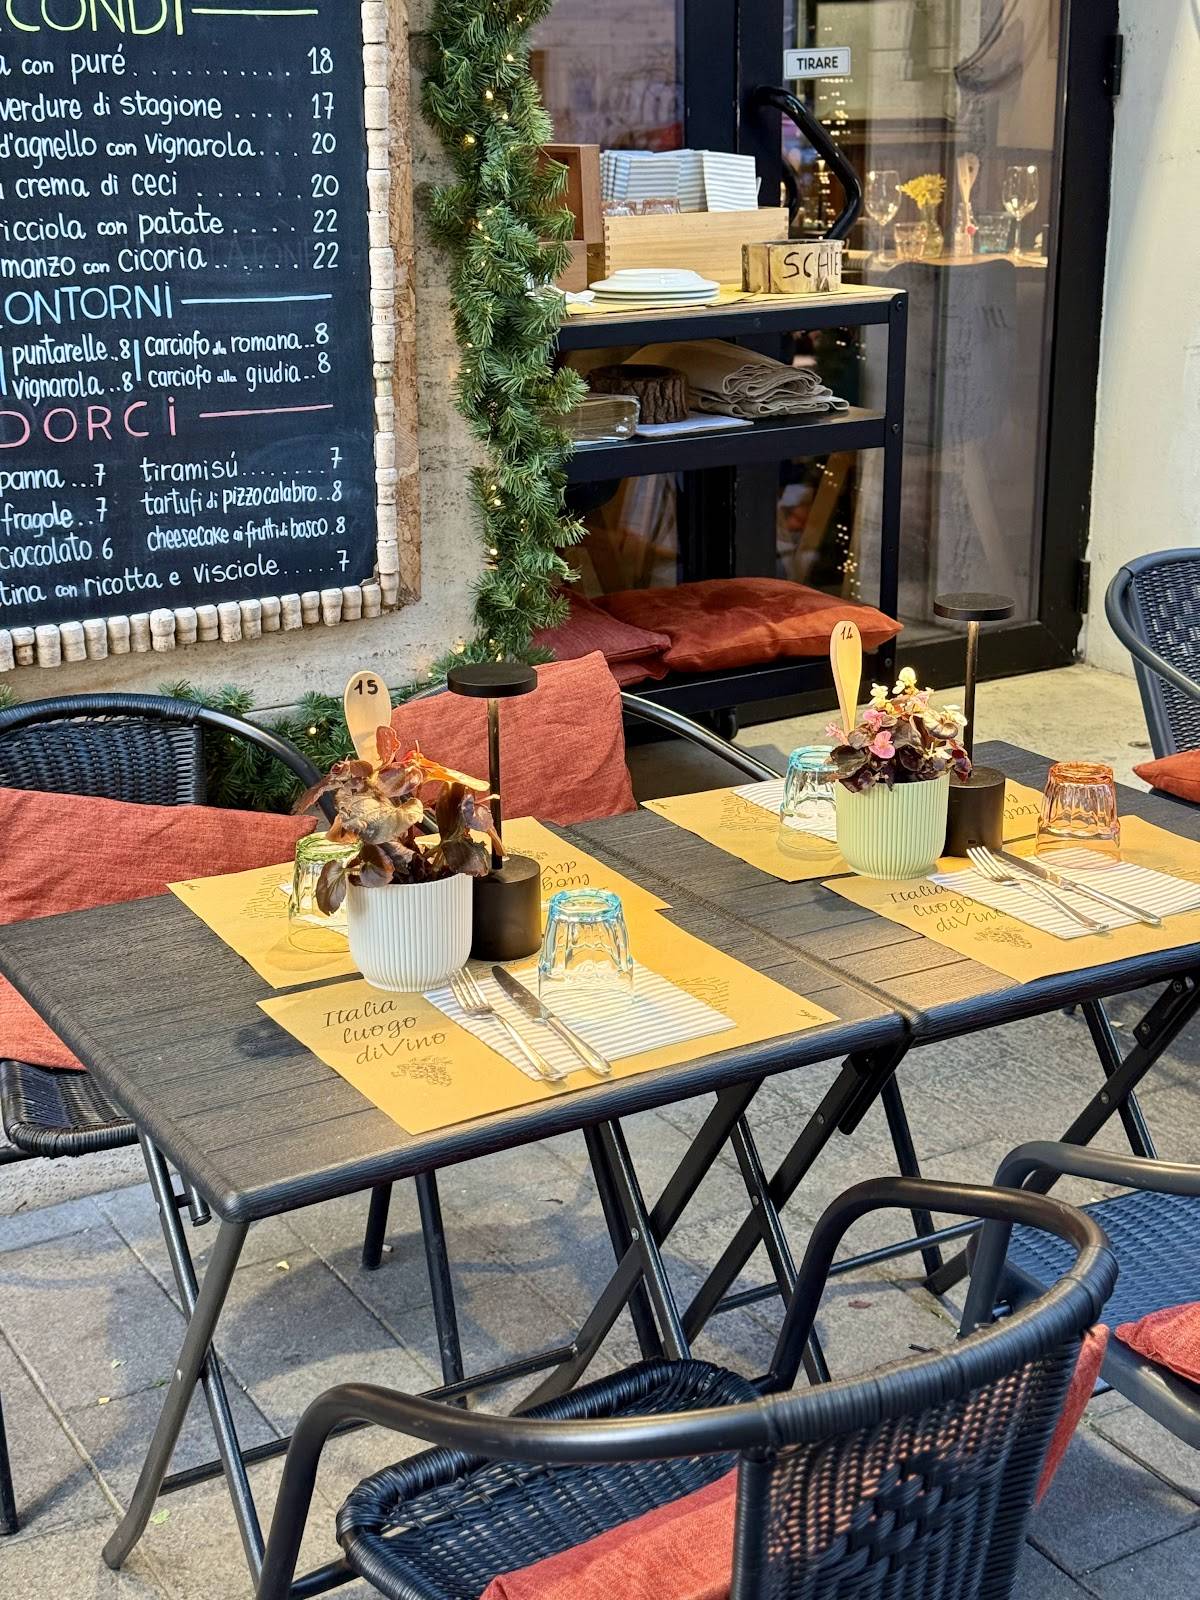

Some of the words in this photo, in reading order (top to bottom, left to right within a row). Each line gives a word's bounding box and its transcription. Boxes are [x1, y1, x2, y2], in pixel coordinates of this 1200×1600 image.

[21, 58, 54, 76] con
[70, 42, 126, 85] puré
[307, 46, 334, 75] 18
[796, 55, 839, 71] TIRARE
[0, 92, 83, 123] verdure
[93, 91, 111, 116] di
[119, 89, 223, 126] stagione
[311, 91, 335, 120] 17
[105, 142, 138, 157] con
[311, 131, 337, 155] 20
[15, 176, 91, 200] crema
[100, 172, 119, 196] di
[310, 173, 340, 198] 20
[0, 212, 87, 242] icciola
[96, 220, 128, 236] con
[138, 203, 225, 244] patate
[312, 208, 338, 234] 22
[0, 255, 76, 280] manzo
[82, 262, 111, 275] con
[312, 241, 339, 270] 22
[11, 332, 109, 377] puntarelle
[118, 338, 131, 360] 8
[144, 329, 211, 360] carciofo
[230, 332, 303, 353] romana
[314, 322, 330, 345] 8
[11, 370, 105, 407] vignarola
[121, 371, 134, 393] 8
[147, 363, 212, 390] carciofo
[245, 360, 302, 393] giudia
[317, 351, 332, 374] 8
[329, 446, 343, 470] 7
[0, 469, 66, 498] panna
[93, 463, 106, 487] 7
[139, 486, 203, 517] tartufi
[205, 490, 219, 510] di
[331, 479, 343, 503] 8
[0, 499, 75, 538] fragole
[95, 496, 108, 523] 7
[232, 525, 244, 542] ai
[244, 516, 280, 549] frutti
[279, 521, 289, 537] di
[289, 517, 329, 540] bosco
[335, 515, 346, 534] 8
[101, 537, 114, 560] 6
[54, 584, 78, 598] con
[84, 566, 163, 597] ricotta
[168, 571, 182, 586] e
[336, 549, 350, 572] 7
[840, 625, 854, 641] 14
[353, 679, 379, 696] 15
[888, 884, 950, 904] Italia
[913, 896, 976, 917] luogo
[320, 999, 398, 1029] Italia
[343, 1016, 418, 1044] luogo
[356, 1032, 447, 1065] diVino
